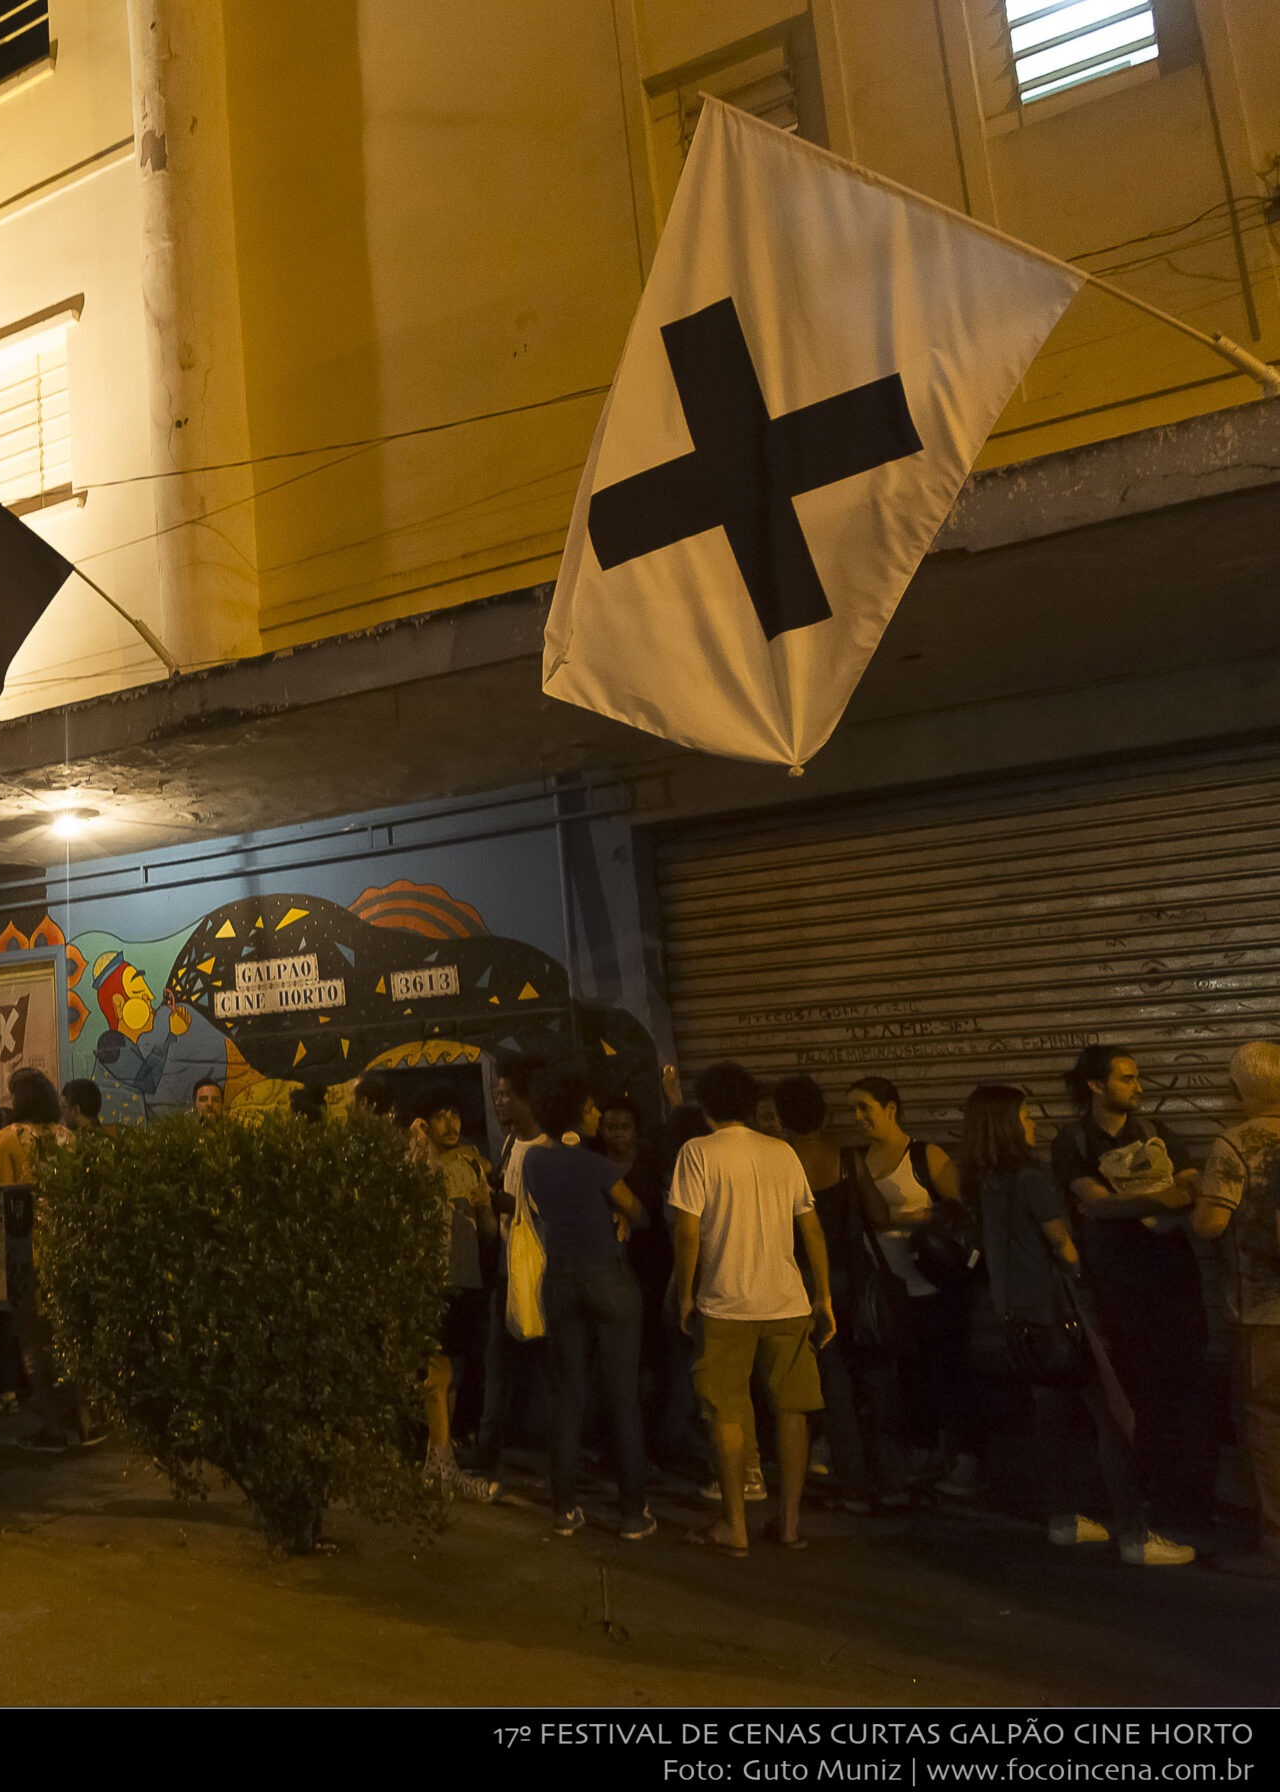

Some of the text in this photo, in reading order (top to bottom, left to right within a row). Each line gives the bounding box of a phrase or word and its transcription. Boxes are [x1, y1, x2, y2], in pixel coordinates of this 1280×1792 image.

[398, 973, 451, 995] 3613
[221, 984, 339, 1013] CINE HORTO
